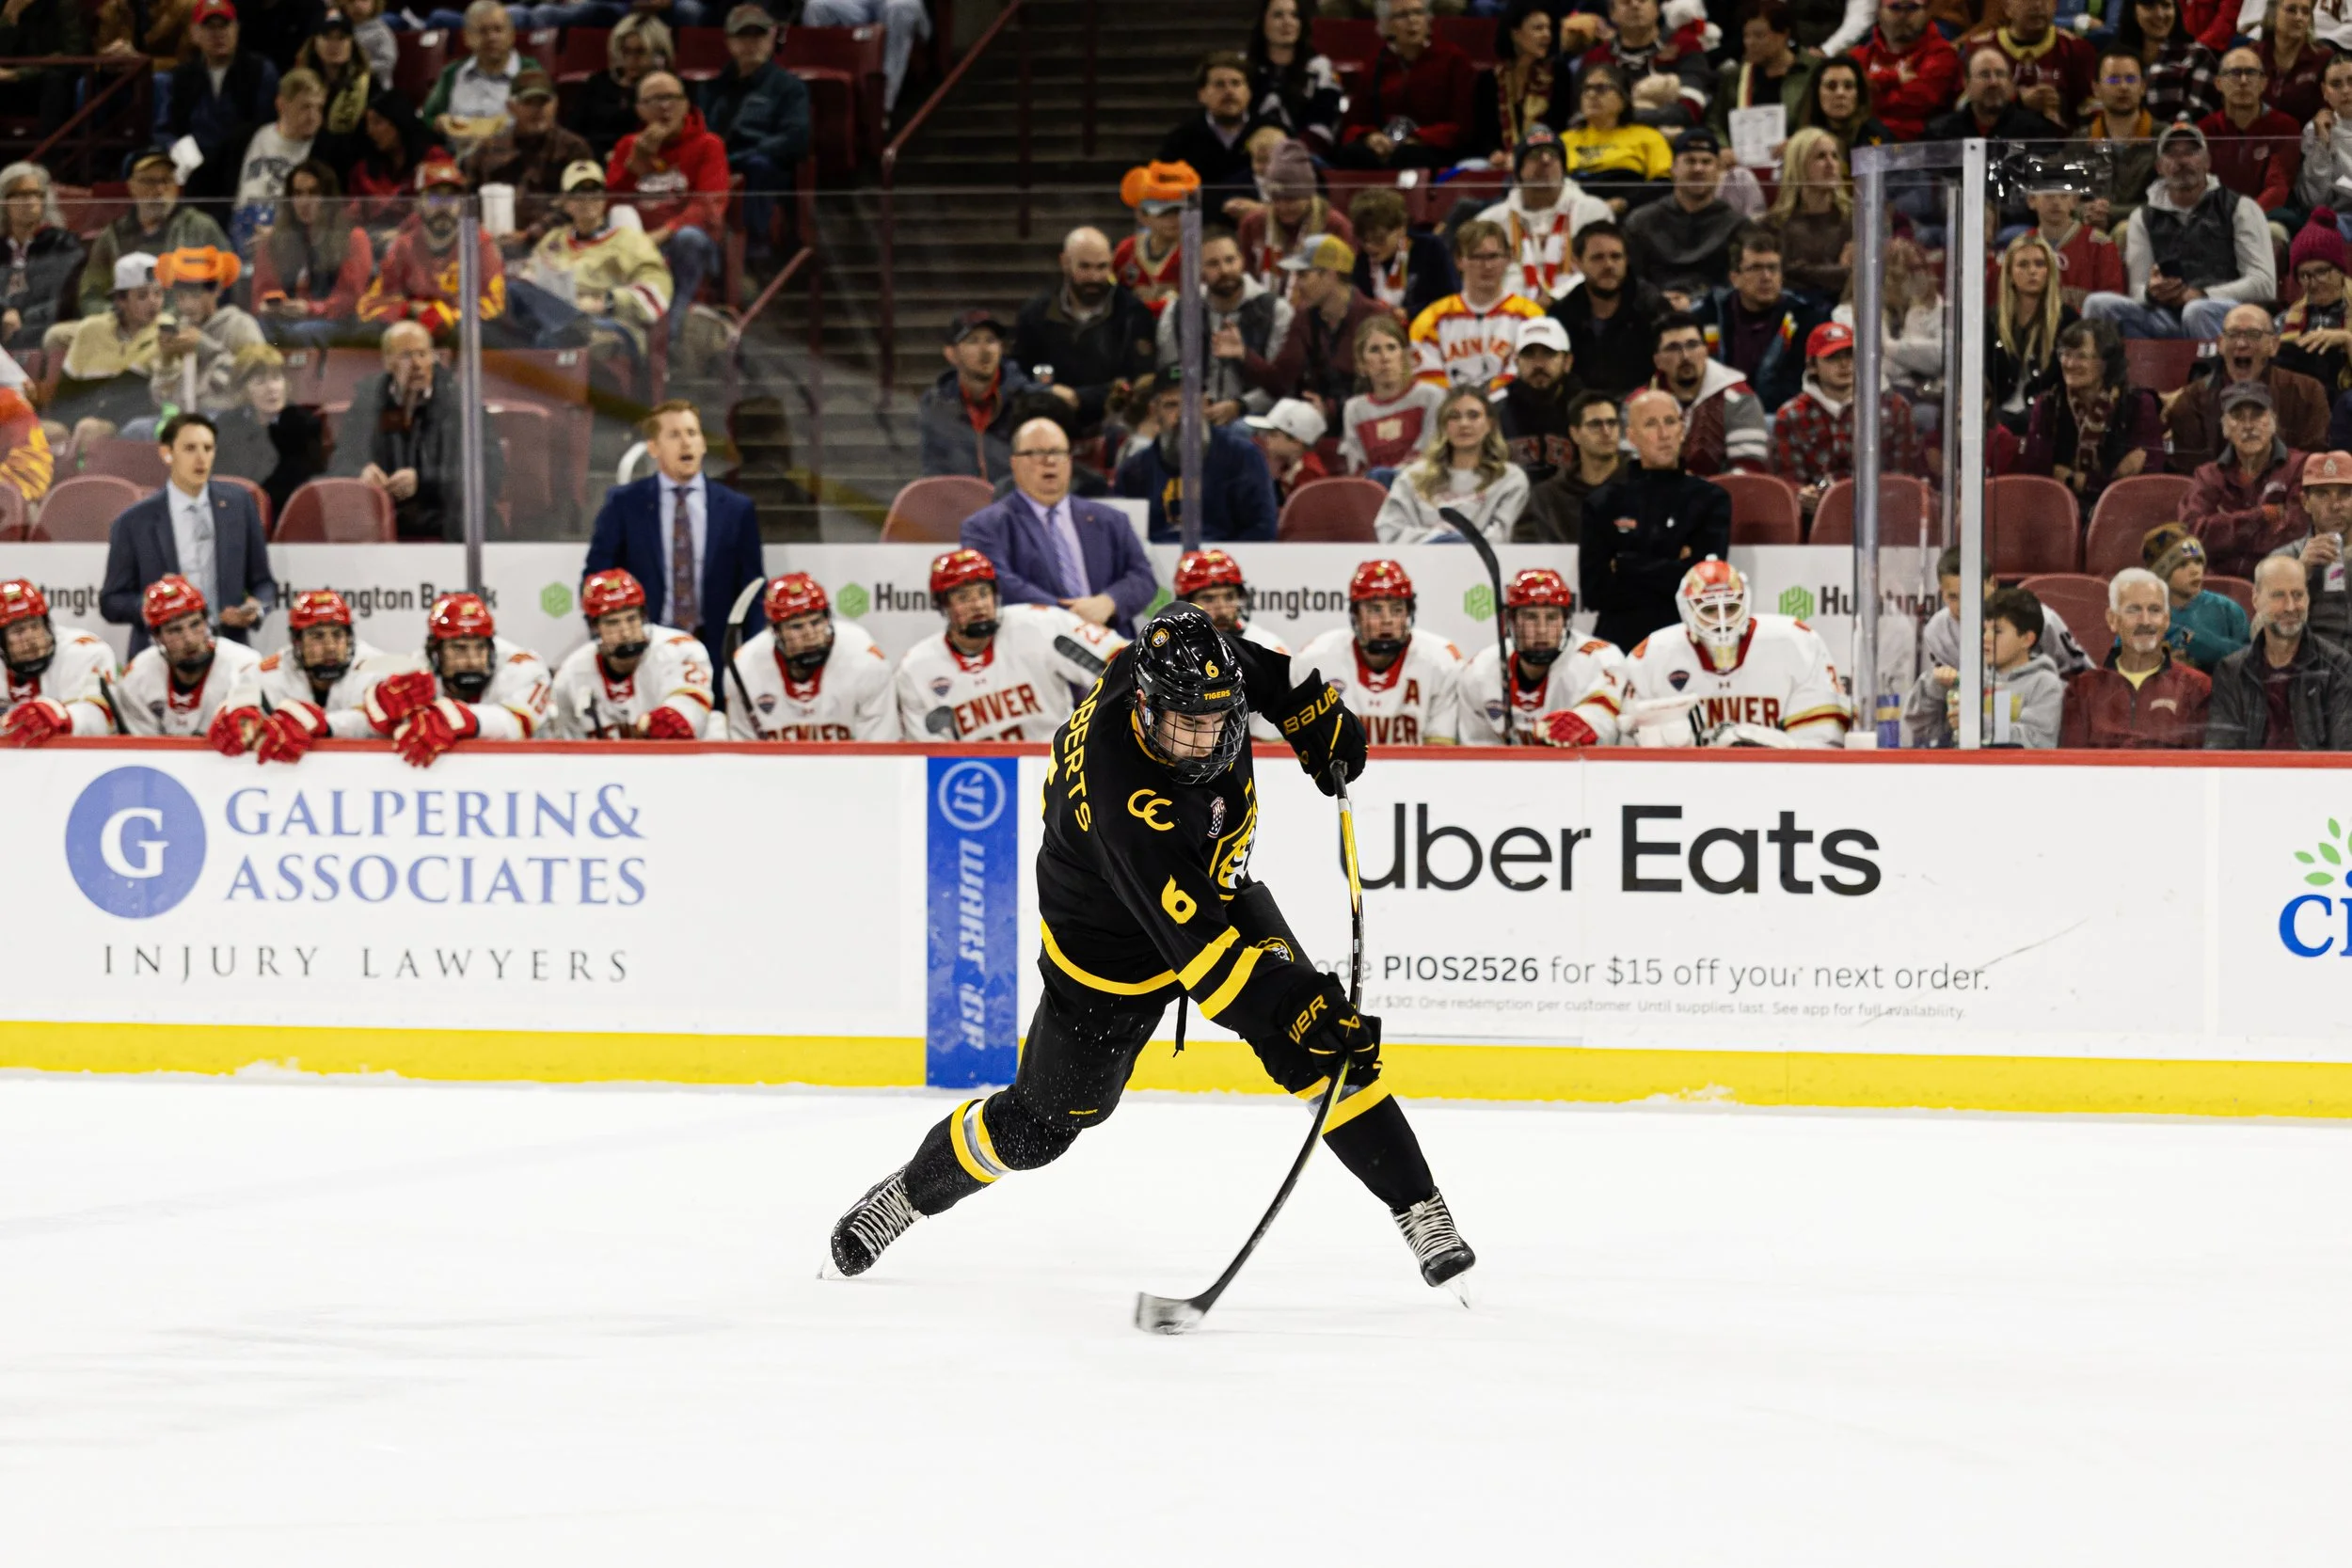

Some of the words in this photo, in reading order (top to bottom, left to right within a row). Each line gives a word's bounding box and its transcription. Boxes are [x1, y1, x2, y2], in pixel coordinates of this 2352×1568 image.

[1248, 585, 1344, 621] tington
[1204, 659, 1219, 678] 6
[955, 683, 1042, 736] ENVER
[1203, 689, 1232, 701] TIGERS
[1403, 679, 1420, 705] A
[1064, 676, 1104, 832] OBERTS
[1127, 788, 1175, 832] CC
[100, 808, 169, 879] G
[1340, 802, 1591, 893] Uber
[1621, 804, 1883, 897] Eats
[224, 854, 647, 906] ASSOCIATES
[1161, 874, 1198, 925] 6
[104, 945, 318, 983] INJURY
[362, 949, 628, 982] LAWYERS
[1384, 955, 1539, 982] PIOS2526
[1550, 956, 1596, 984] for
[1606, 955, 1663, 987] $15
[1674, 958, 1720, 986] off
[1728, 966, 1804, 994] your
[1815, 963, 1883, 989] next
[1895, 962, 1989, 990] order.
[1419, 995, 1447, 1010] One
[1451, 995, 1534, 1013] redemption
[1537, 1000, 1561, 1014] per
[1637, 1000, 1671, 1014] Until
[1676, 1000, 1734, 1016] supplies
[1772, 1002, 1799, 1016] See
[1803, 1005, 1830, 1019] app
[1834, 1003, 1854, 1016] for
[1858, 1004, 1882, 1018] full
